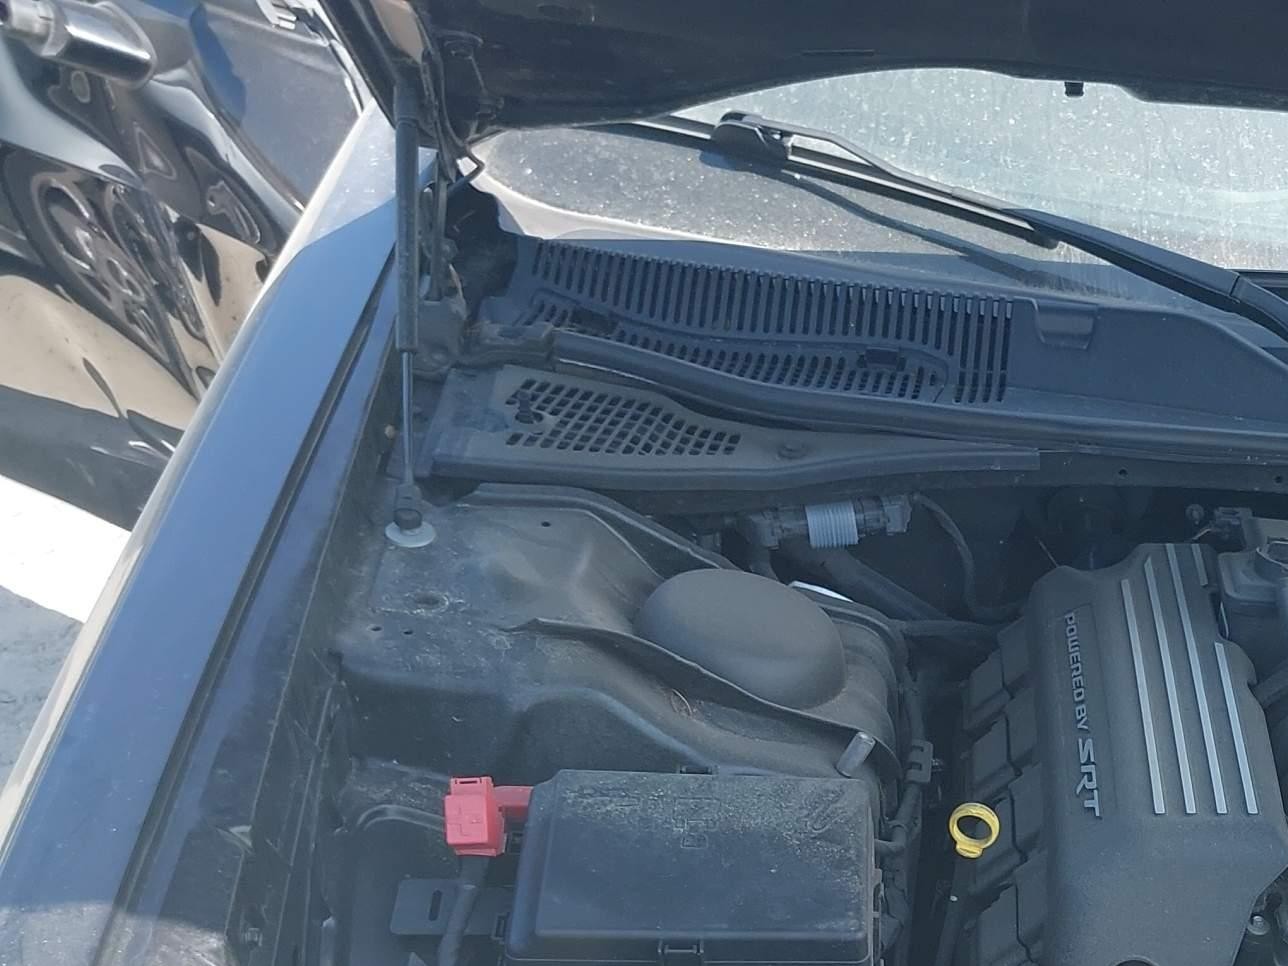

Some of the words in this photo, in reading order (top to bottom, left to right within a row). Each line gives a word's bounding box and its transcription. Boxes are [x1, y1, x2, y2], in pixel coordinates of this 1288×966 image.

[1065, 612, 1085, 702] POWERED
[1075, 704, 1089, 731] BY
[1076, 737, 1101, 817] SRT
